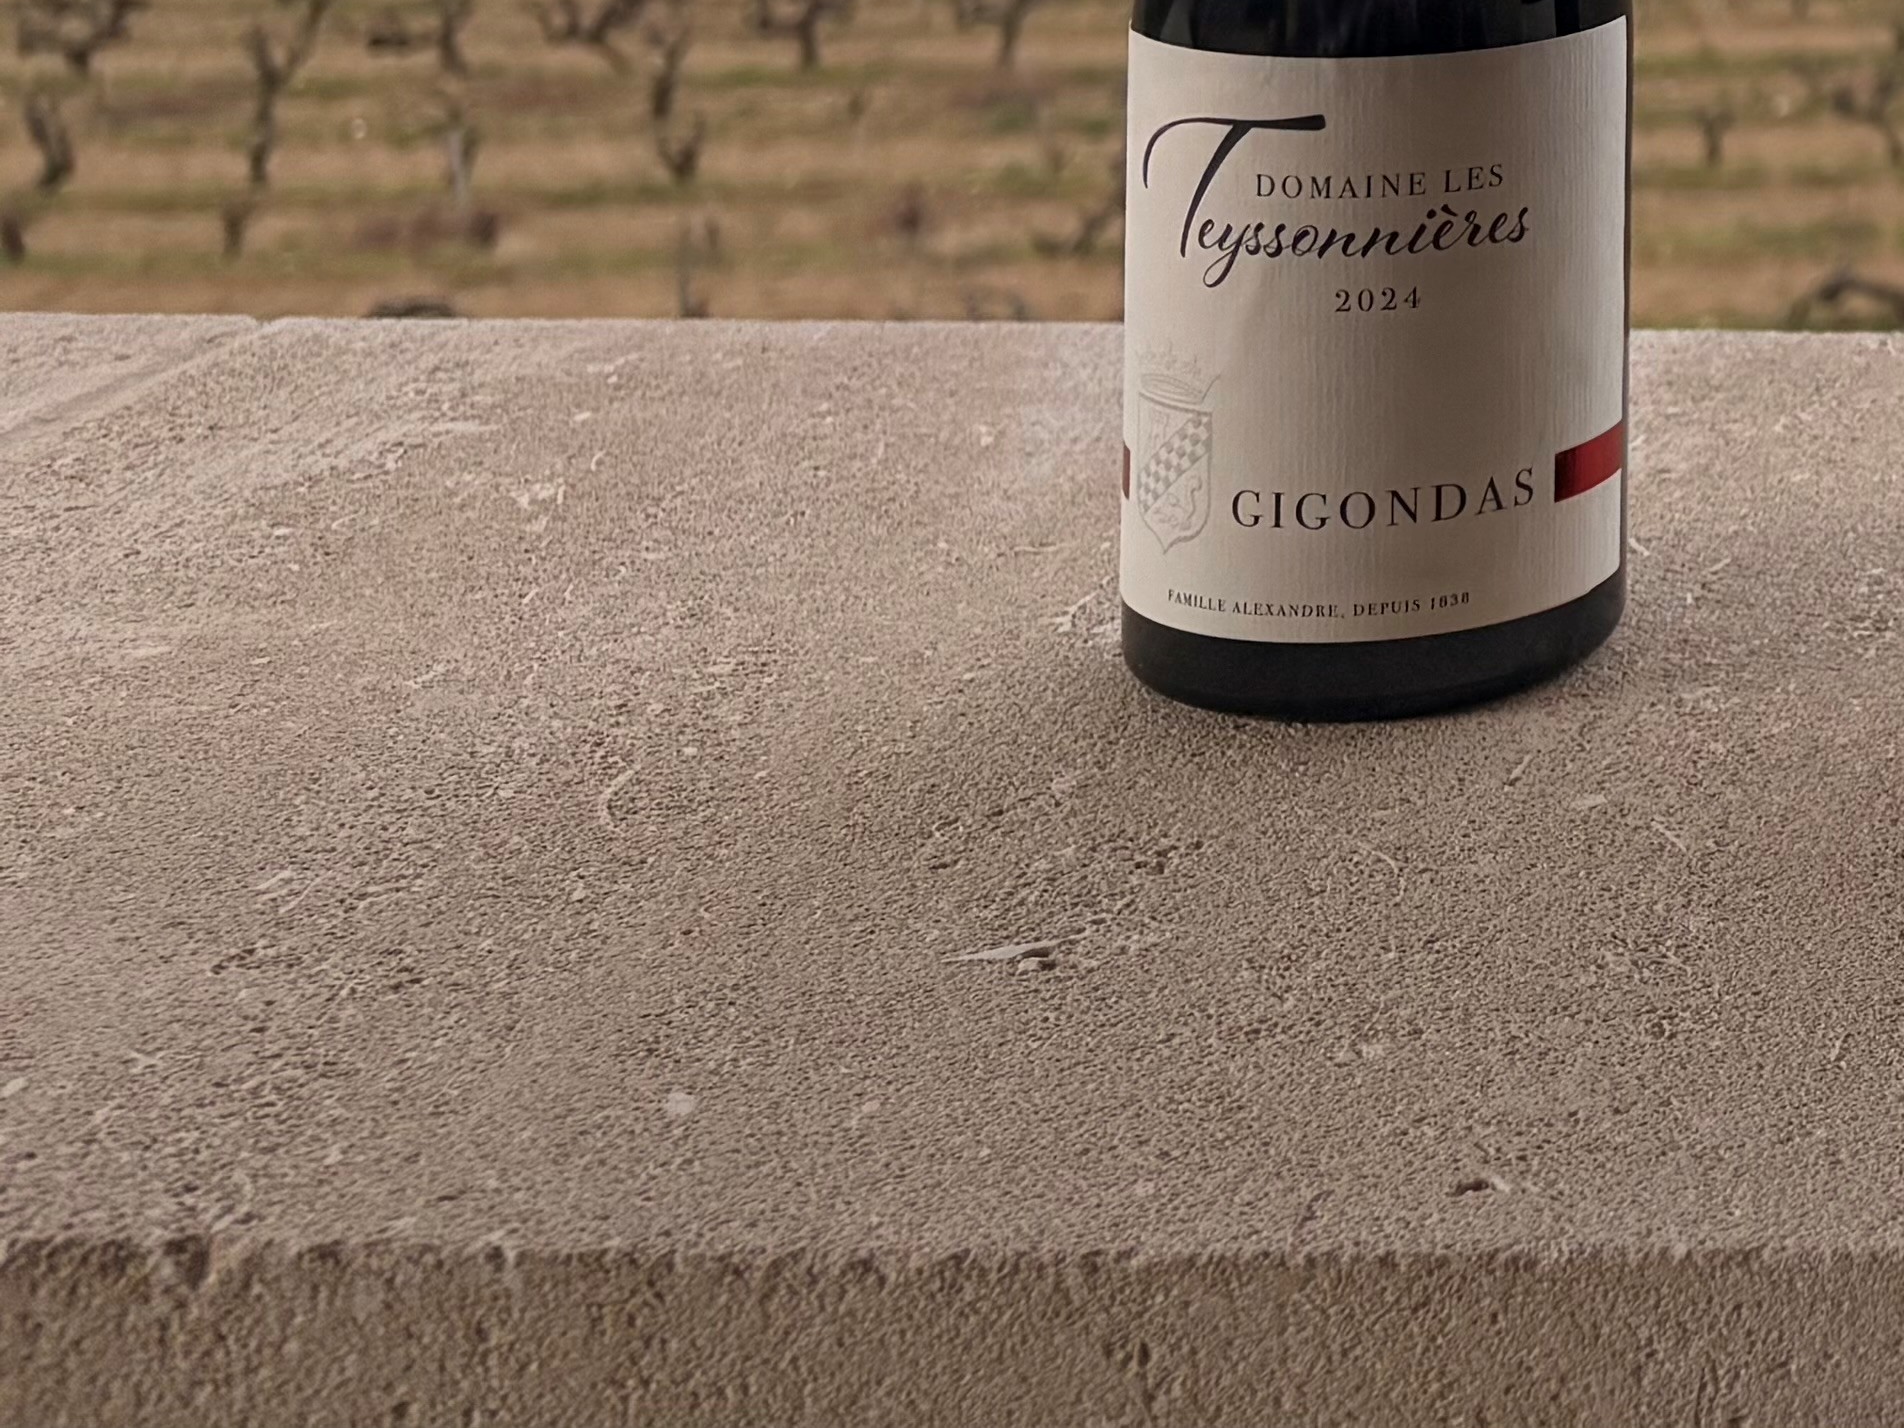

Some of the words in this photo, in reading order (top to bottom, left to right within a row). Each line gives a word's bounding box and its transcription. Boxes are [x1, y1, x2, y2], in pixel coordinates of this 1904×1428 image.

[1255, 170, 1428, 201] DOMAINE
[1443, 163, 1505, 194] LES
[1142, 114, 1530, 289] Teyssonnières
[1334, 286, 1422, 313] 2024
[1230, 466, 1536, 531] GIGONDAS
[1167, 588, 1226, 614] FAMILLE
[1353, 595, 1421, 618] DEPUIS
